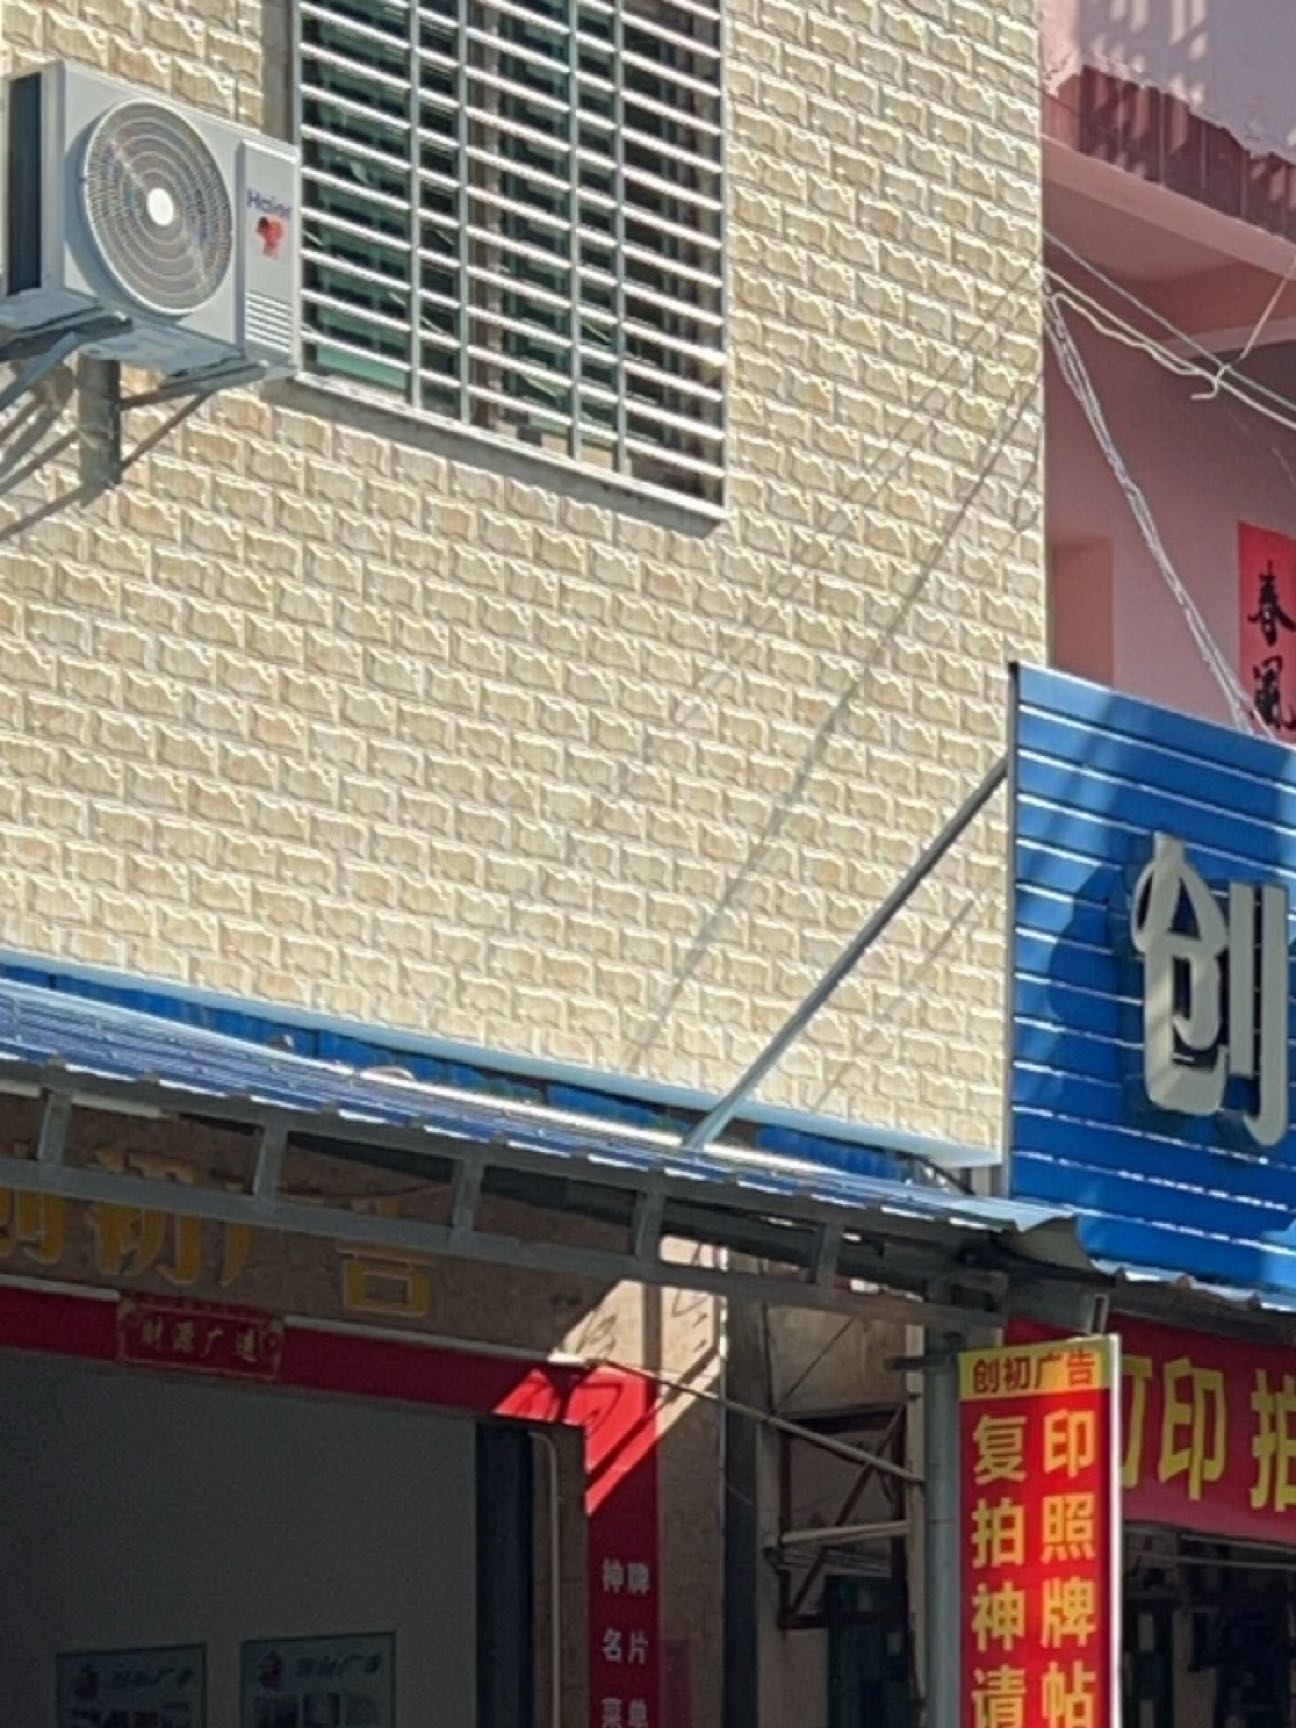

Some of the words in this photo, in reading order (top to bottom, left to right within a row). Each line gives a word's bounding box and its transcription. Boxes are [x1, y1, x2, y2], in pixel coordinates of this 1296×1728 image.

[972, 1347, 1096, 1394] 创初广告
[972, 1408, 1097, 1485] 复印
[971, 1491, 1096, 1570] 拍照
[601, 1627, 649, 1665] 名片
[971, 1575, 1096, 1653] 神牌
